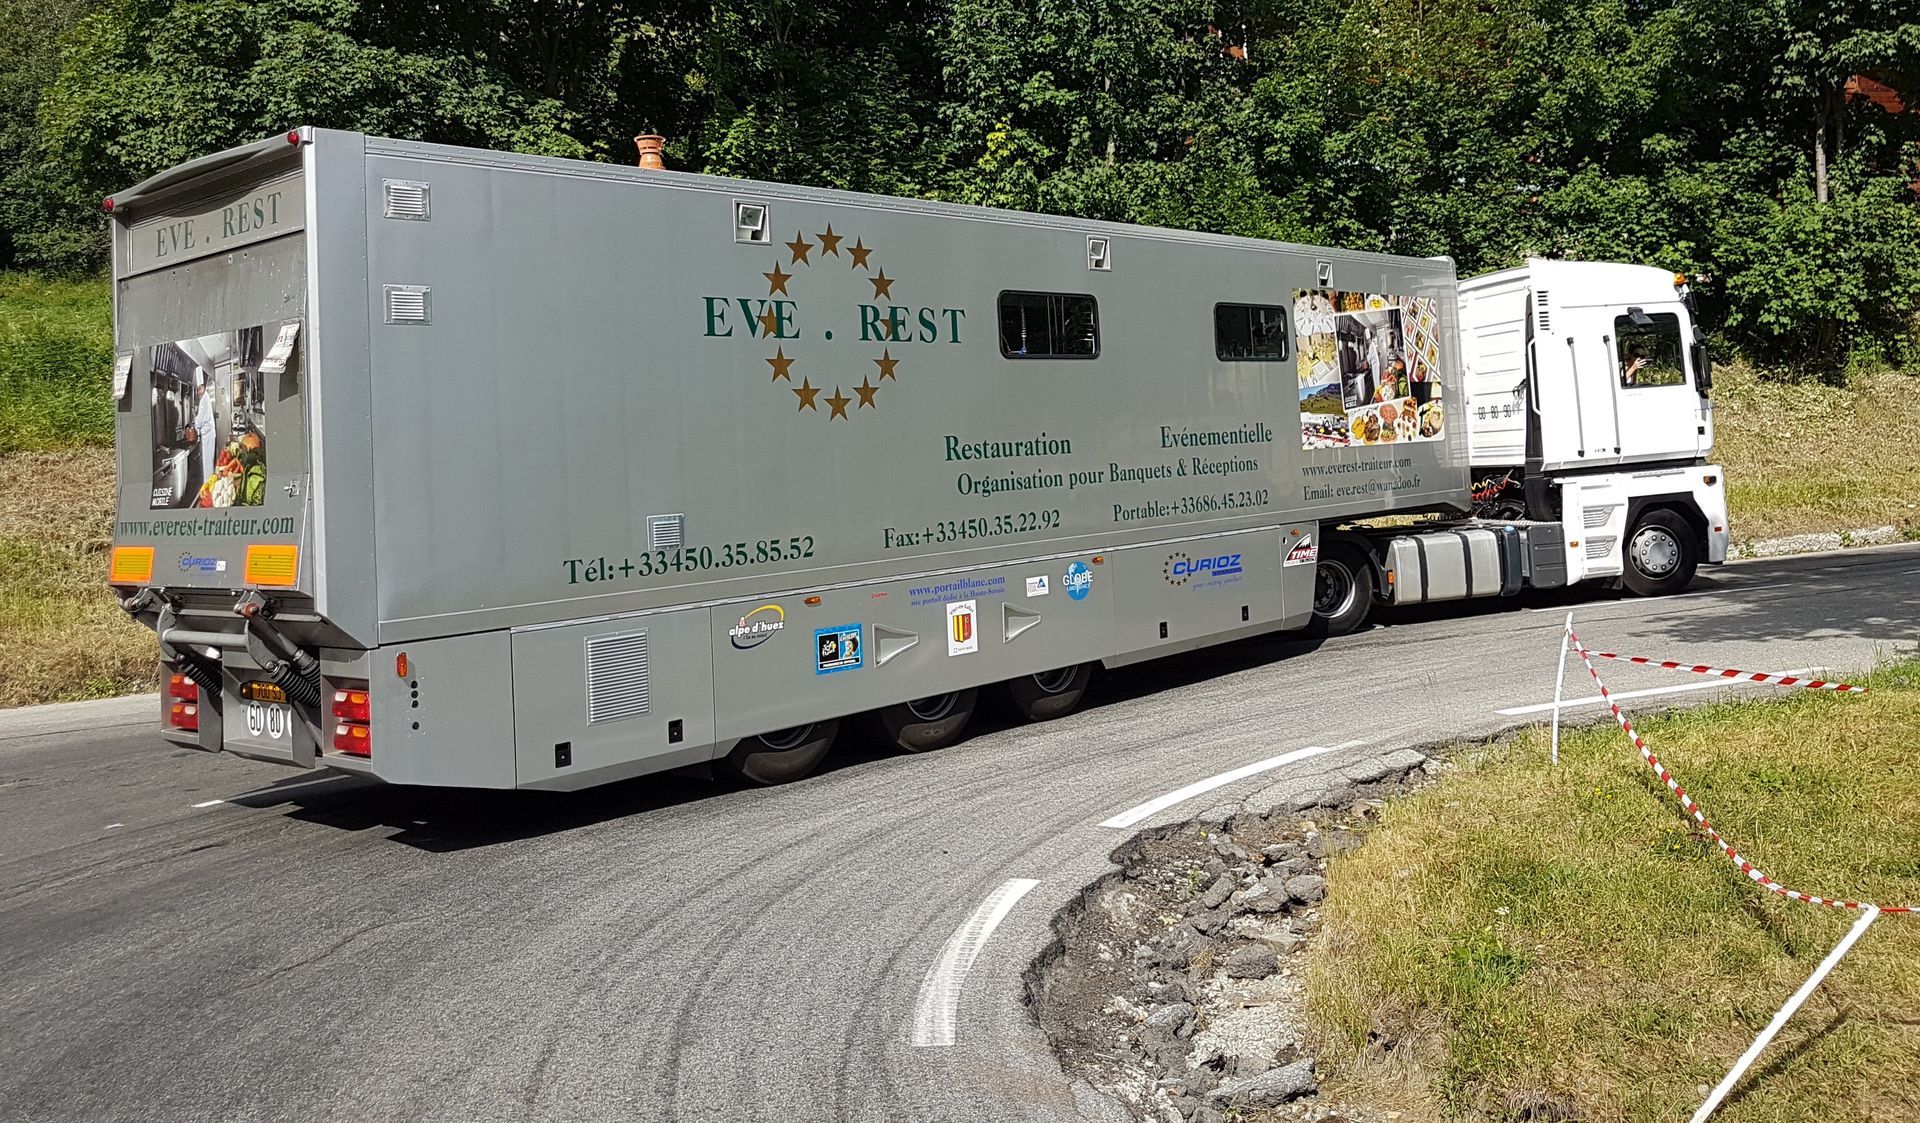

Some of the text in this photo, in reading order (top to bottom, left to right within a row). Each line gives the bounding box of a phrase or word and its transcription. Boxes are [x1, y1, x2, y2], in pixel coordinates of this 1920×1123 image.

[156, 218, 196, 258] EVE
[222, 191, 282, 240] REST
[702, 296, 801, 340] EVE
[857, 303, 966, 344] REST
[944, 431, 1072, 461] Restauration
[1160, 422, 1273, 449] Evénementielle
[957, 455, 1259, 498] Organisation pour Banquets & Réceptions
[1301, 457, 1412, 477] www.everest-traiteur.com
[1303, 473, 1421, 501] Email: eve.rest@wanadoo.fr
[120, 511, 294, 537] www.everest-traiteur.com
[1173, 553, 1242, 575] CURIOZ
[1291, 549, 1316, 560] TIME
[909, 576, 1005, 597] www.portailblanc.com
[1062, 571, 1094, 586] GLOBE
[729, 624, 751, 638] alpe
[752, 621, 785, 633] d'huez
[250, 704, 261, 732] 60
[269, 707, 281, 734] 80
